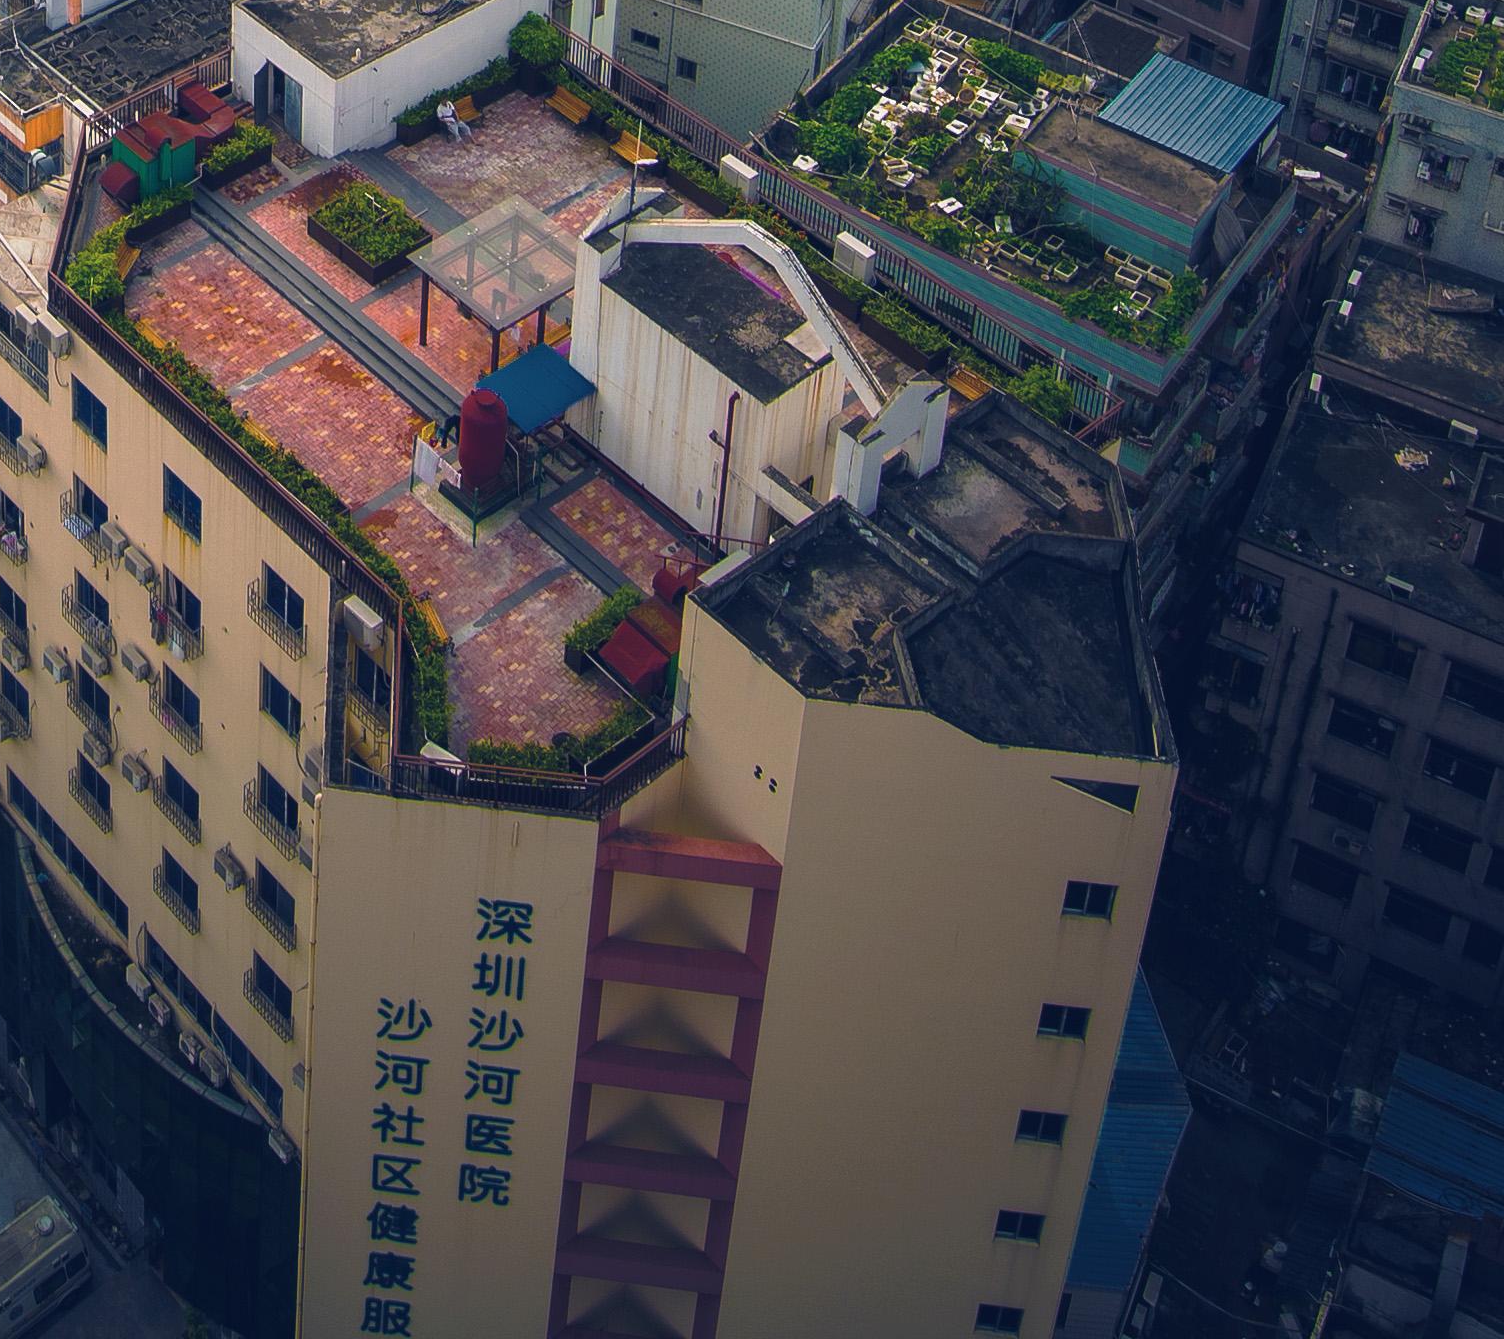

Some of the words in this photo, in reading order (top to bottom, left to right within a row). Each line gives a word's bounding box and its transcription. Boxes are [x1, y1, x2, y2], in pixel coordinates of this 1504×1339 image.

[360, 996, 433, 1338] 沙河社区健康服
[457, 896, 534, 1207] 深圳沙河医院
